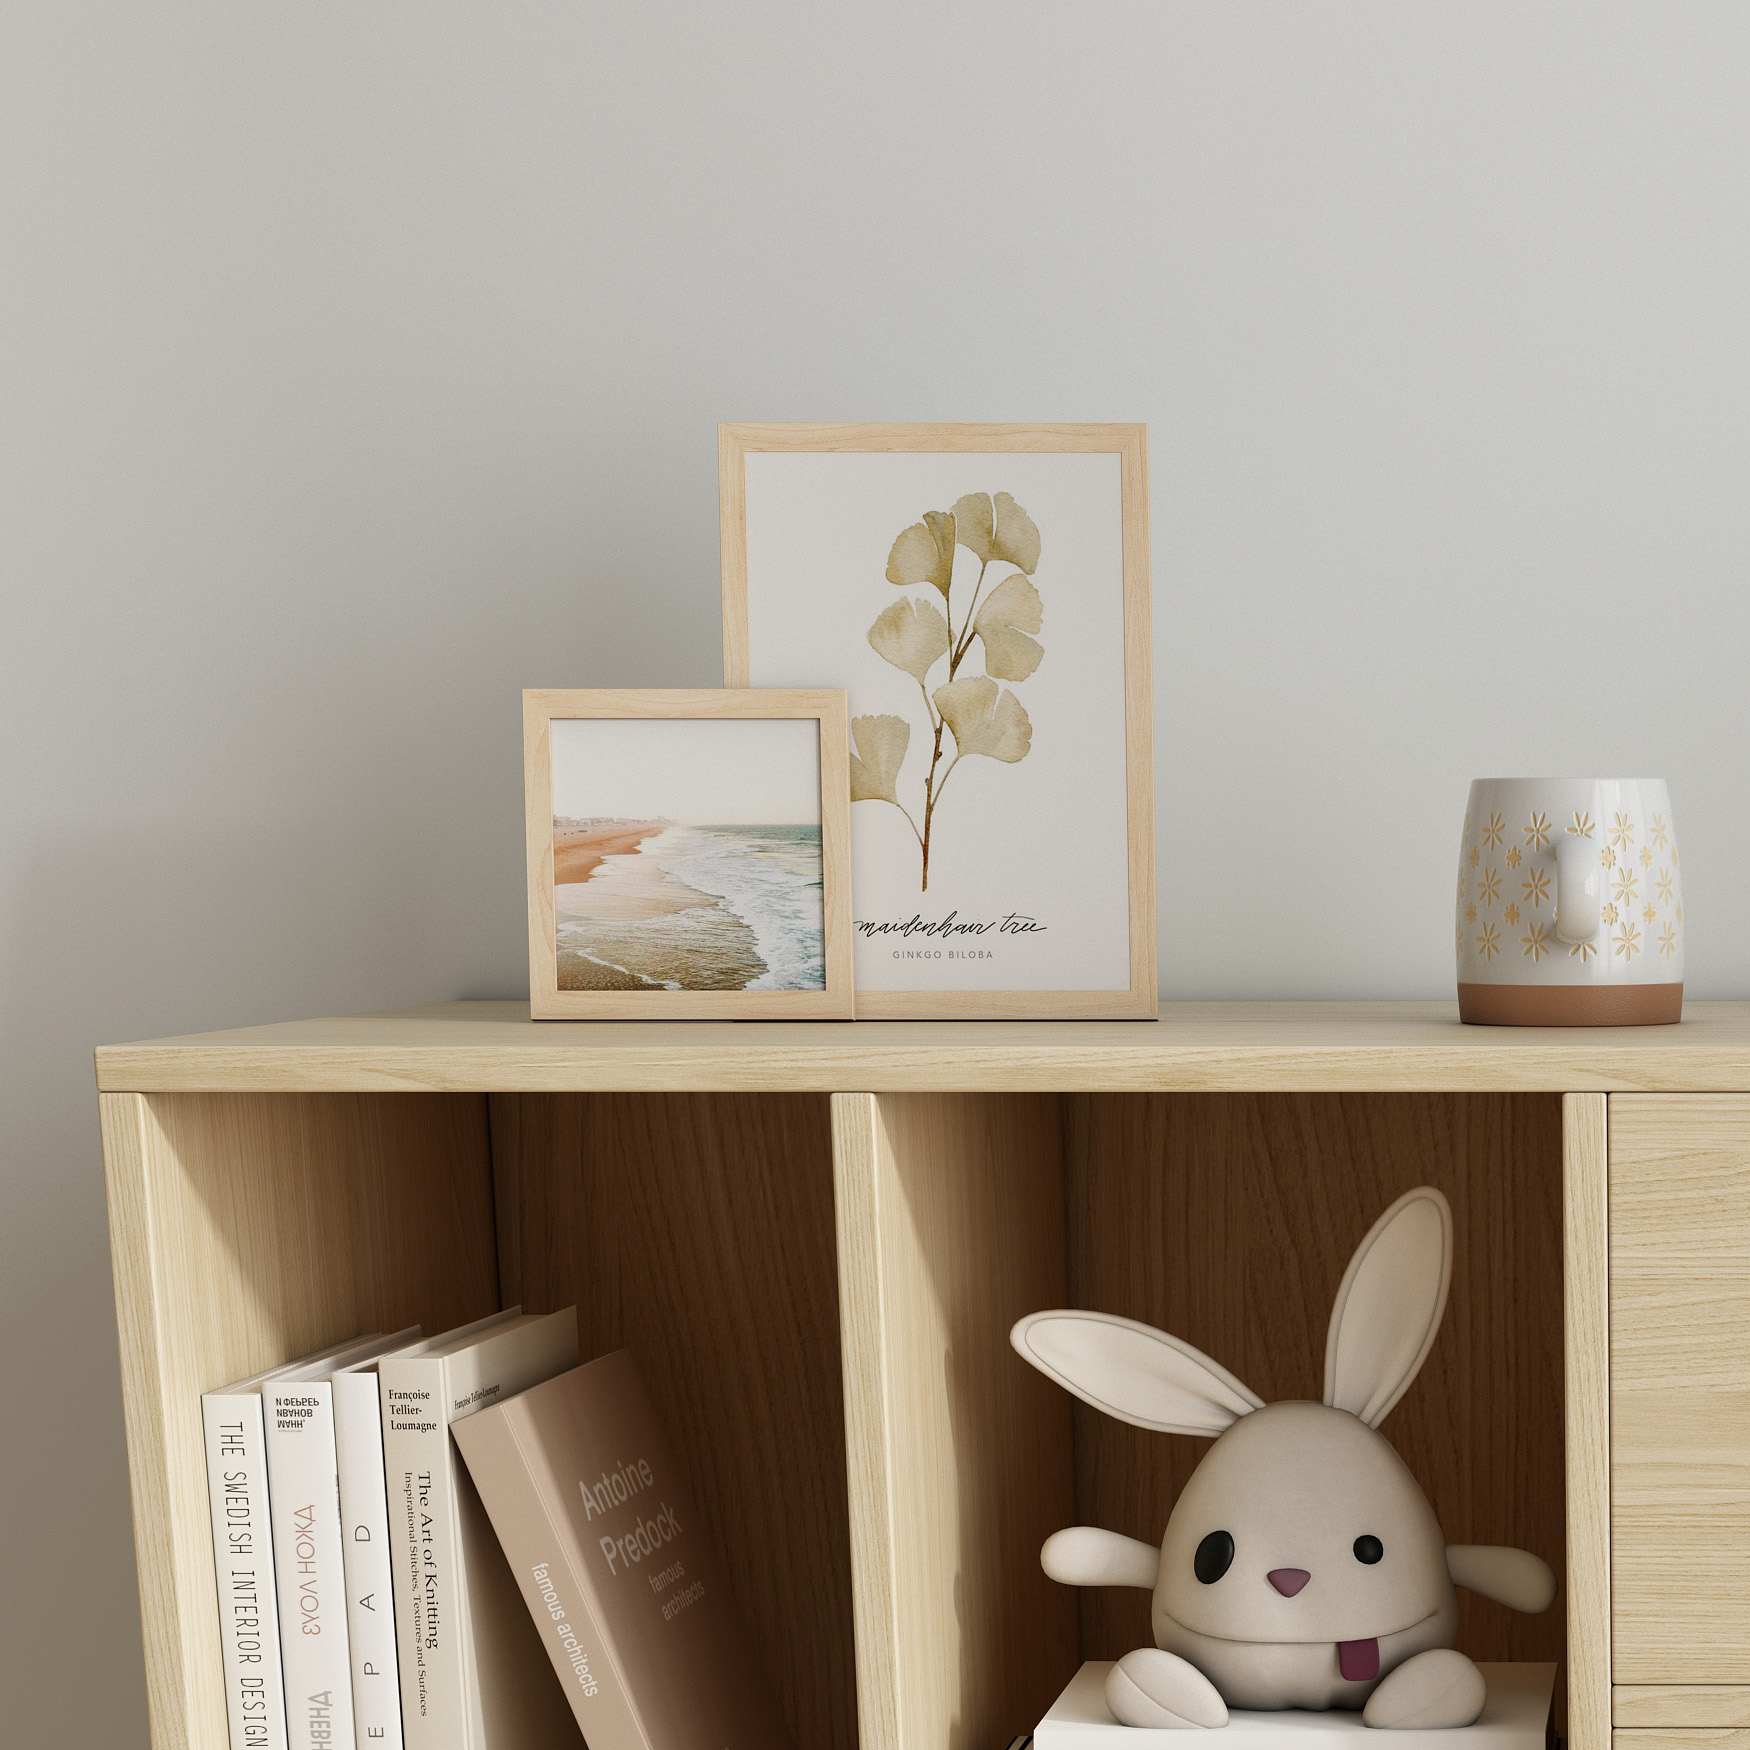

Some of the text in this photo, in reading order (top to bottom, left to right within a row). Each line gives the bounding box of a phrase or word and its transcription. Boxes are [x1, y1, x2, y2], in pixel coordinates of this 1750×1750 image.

[853, 911, 1048, 938] maidenhair tree
[892, 951, 993, 959] GINKGO BILOBA
[388, 1389, 431, 1402] Françoise
[389, 1404, 423, 1415] Tellier-
[219, 1422, 246, 1456] THE
[391, 1420, 437, 1433] Loumagne
[223, 1472, 253, 1554] SWEDISH
[579, 1458, 654, 1521] Antoine
[418, 1471, 438, 1649] The Art of Knitting
[600, 1502, 684, 1576] Predock
[403, 1472, 427, 1717] Inspirational Stitches, Textures and Surfaces
[648, 1560, 686, 1593] famous
[661, 1580, 705, 1621] architects
[231, 1571, 262, 1664] INTERIOR
[531, 1562, 599, 1697] famous architects
[240, 1678, 268, 1748] DESIGN
